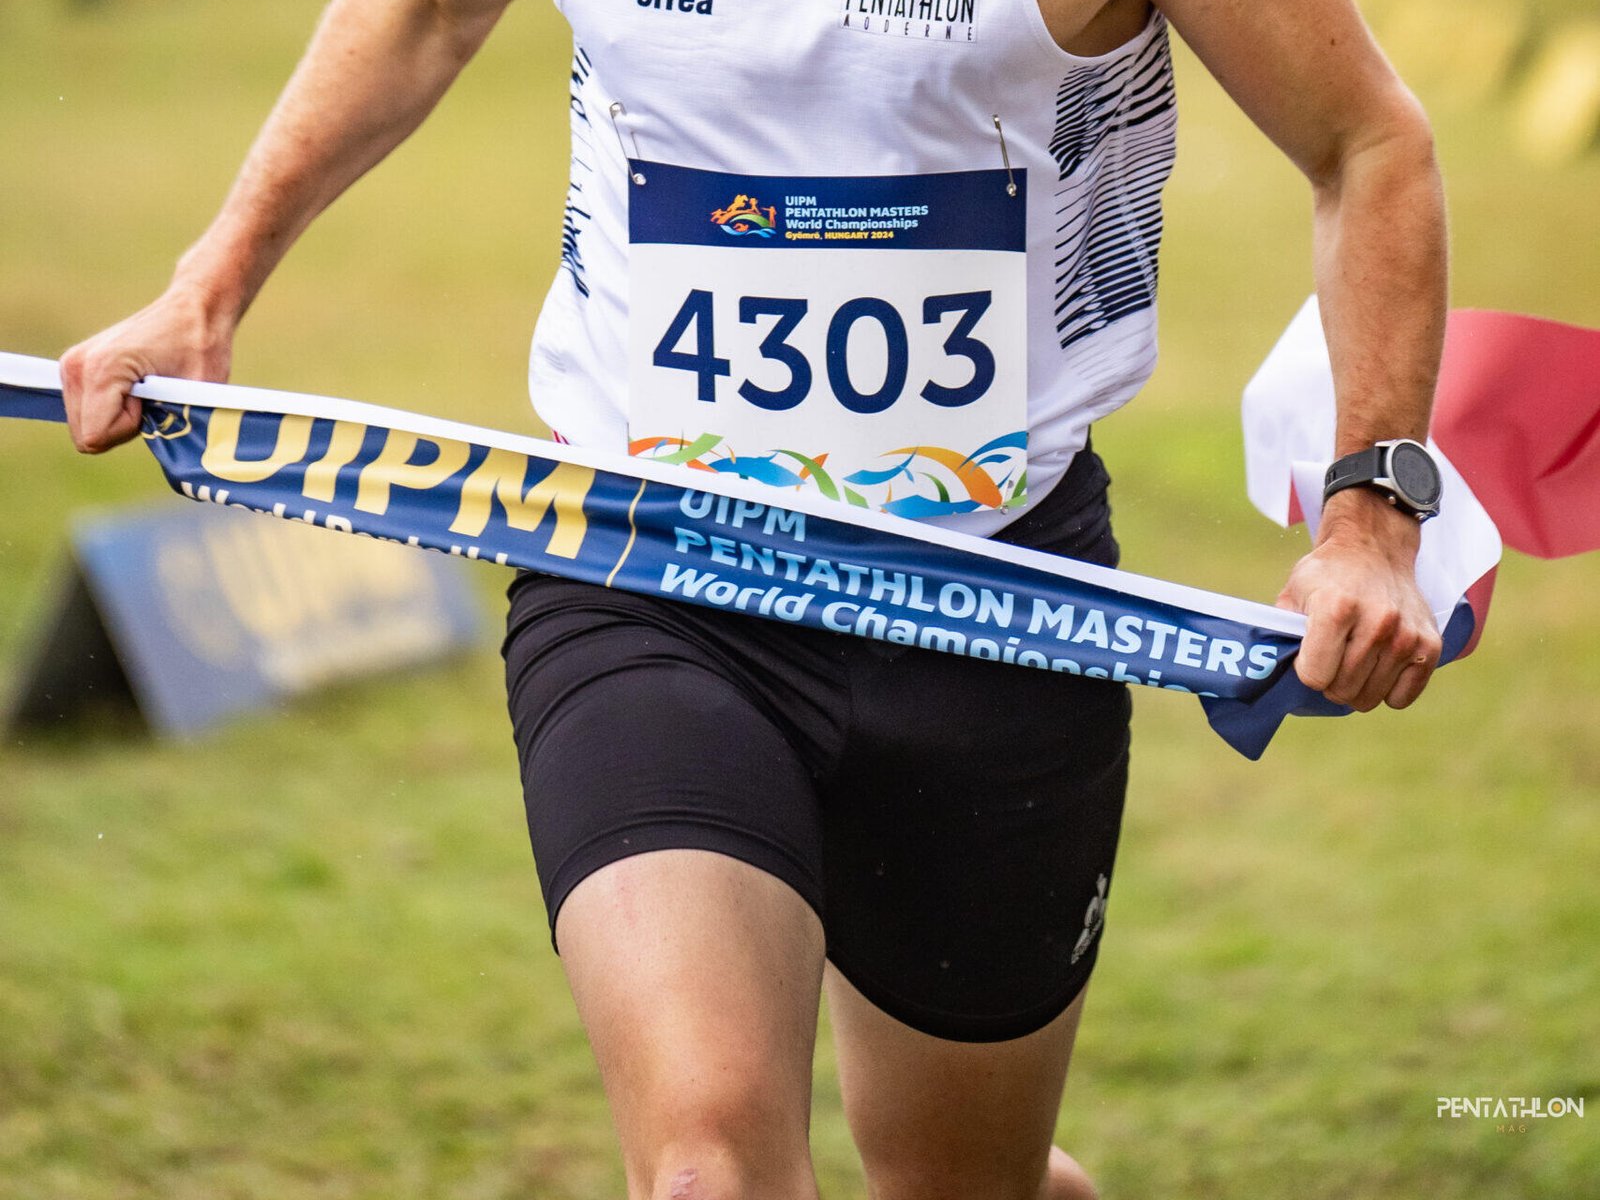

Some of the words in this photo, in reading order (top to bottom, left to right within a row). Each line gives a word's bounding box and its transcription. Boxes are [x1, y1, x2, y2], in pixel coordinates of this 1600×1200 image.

[785, 196, 817, 206] UIPM
[785, 208, 867, 218] PENTATHLON
[870, 205, 929, 217] MASTERS
[785, 219, 823, 230] World
[825, 218, 919, 230] Championships
[824, 231, 869, 240] HUNGARY
[871, 231, 894, 239] 2024
[653, 288, 996, 414] 4303
[200, 407, 597, 560] UIPM
[679, 488, 807, 542] UIPM
[660, 562, 816, 622] World
[674, 526, 1013, 627] PENTATHLON
[1029, 597, 1278, 680] MASTERS
